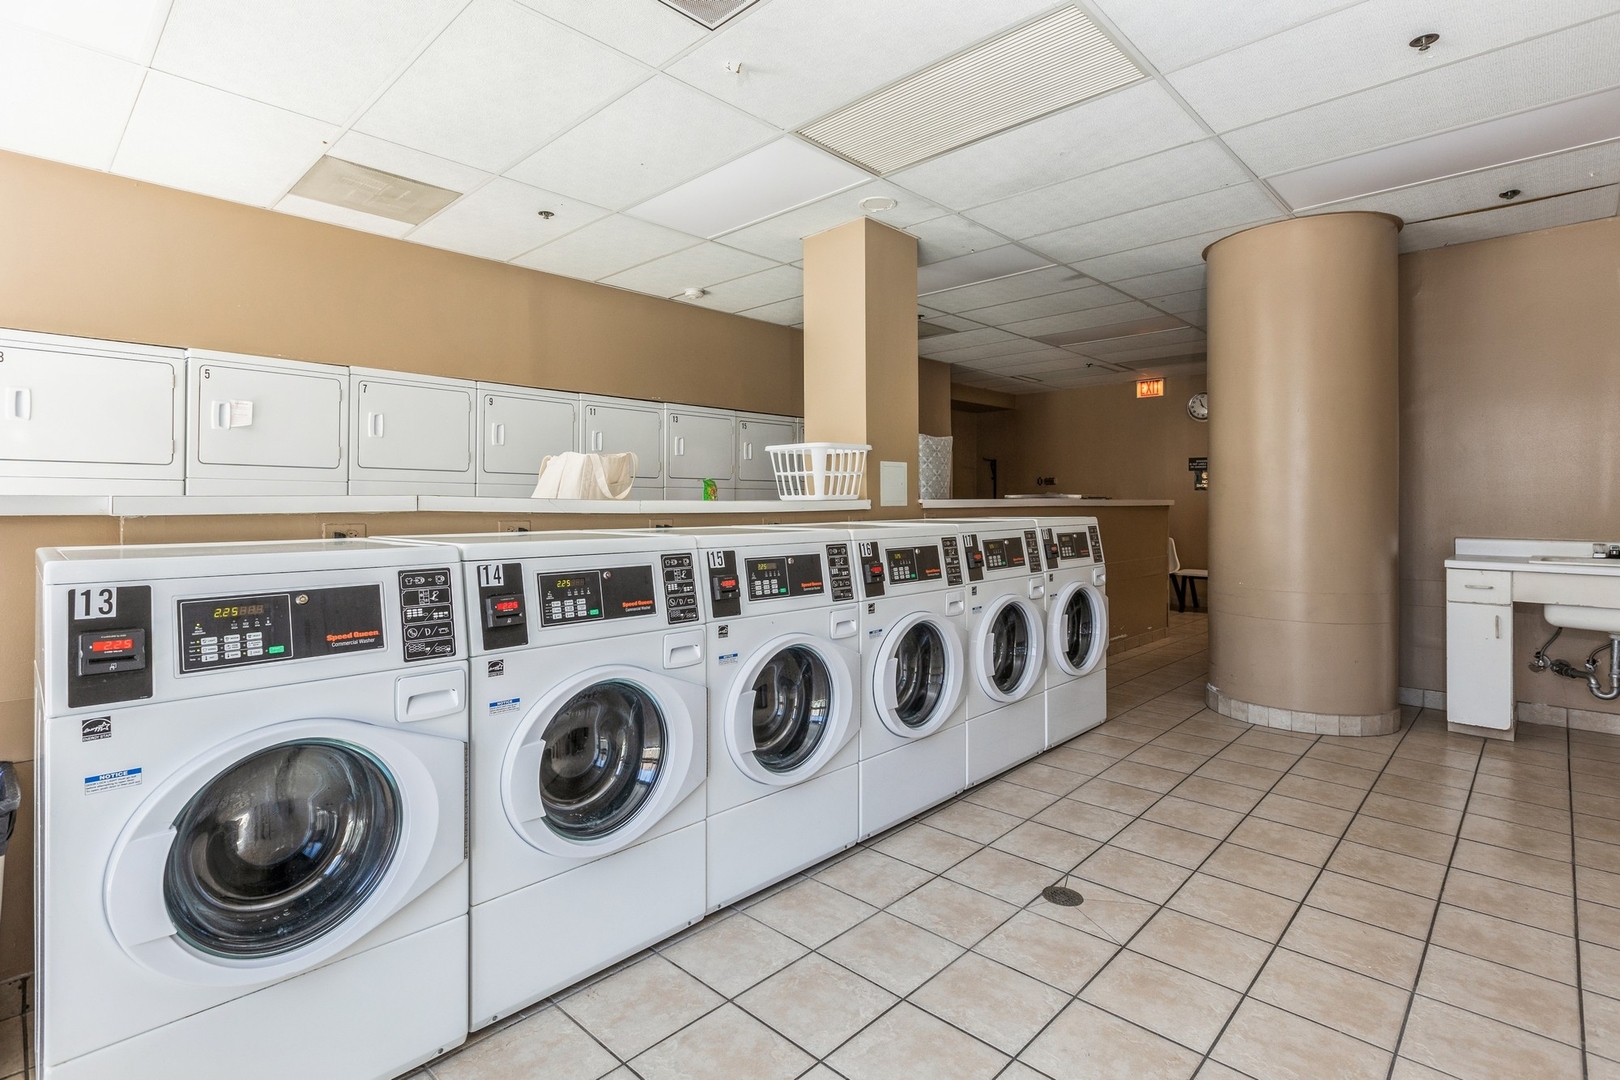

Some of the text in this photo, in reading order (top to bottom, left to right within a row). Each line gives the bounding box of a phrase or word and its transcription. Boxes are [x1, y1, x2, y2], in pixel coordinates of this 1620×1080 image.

[204, 368, 210, 379] 5
[363, 384, 368, 393] 7
[1140, 381, 1159, 395] EXIT
[489, 397, 494, 406] 9
[589, 407, 596, 416] 11
[672, 415, 679, 423] 13
[964, 535, 972, 546] 17
[861, 542, 872, 556] 16
[710, 551, 723, 567] 15
[483, 564, 502, 585] 14
[80, 588, 113, 617] 13
[622, 601, 637, 609] Speed
[326, 630, 379, 642] Speed Queen
[99, 770, 128, 781] NOTICE
